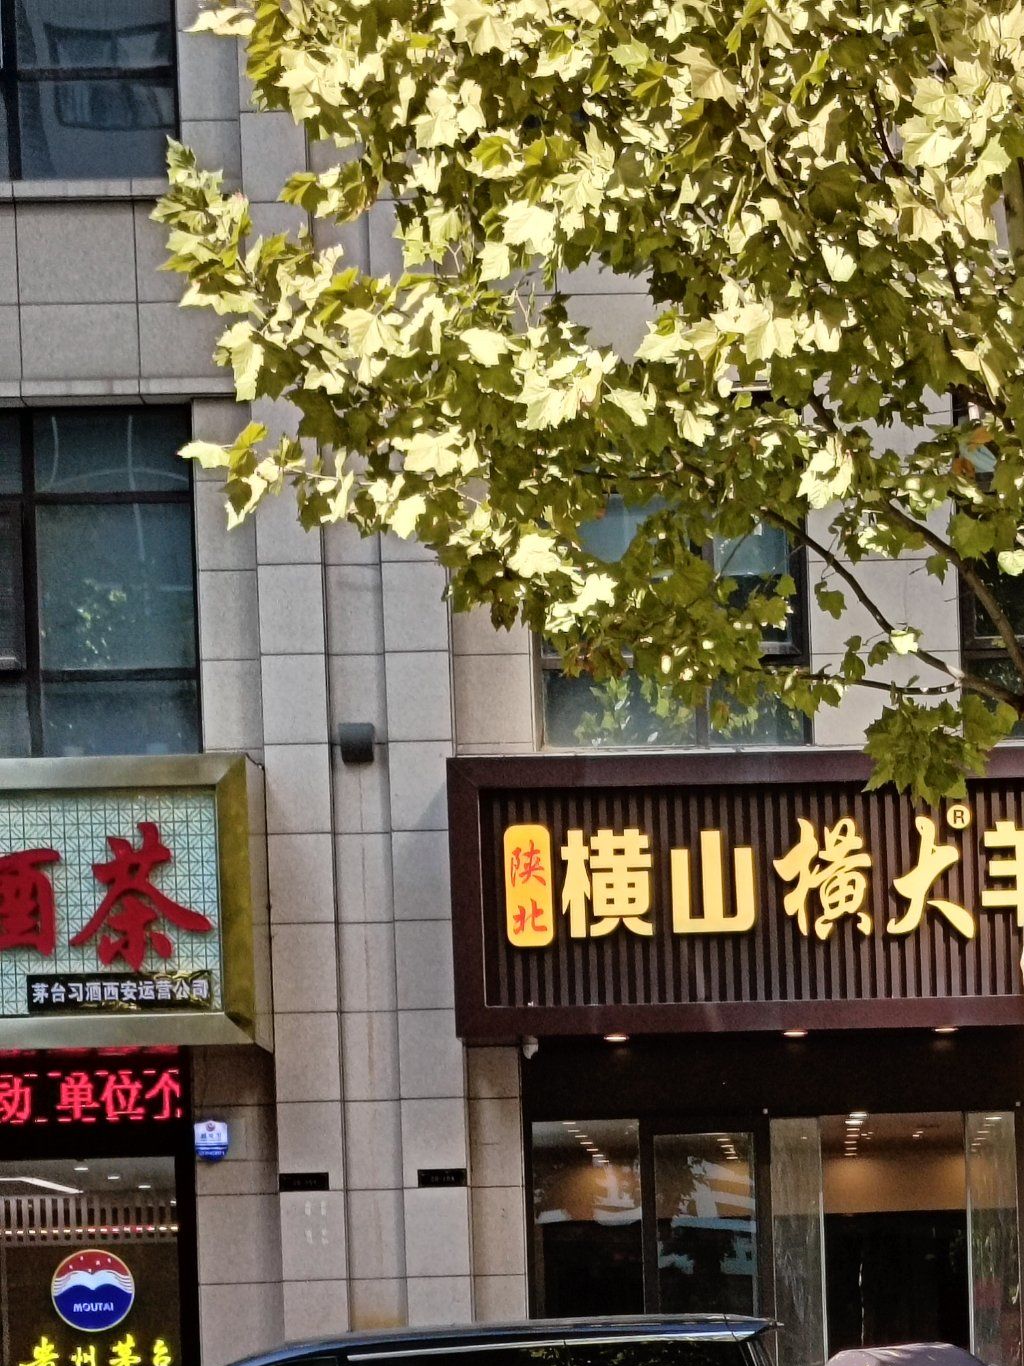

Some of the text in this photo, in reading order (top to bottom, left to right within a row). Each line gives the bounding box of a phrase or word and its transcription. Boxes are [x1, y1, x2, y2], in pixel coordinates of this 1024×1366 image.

[510, 839, 548, 935] 陕北
[31, 979, 208, 1003] 茅台习酒西安运营公司
[73, 1302, 114, 1312] MOUTAI
